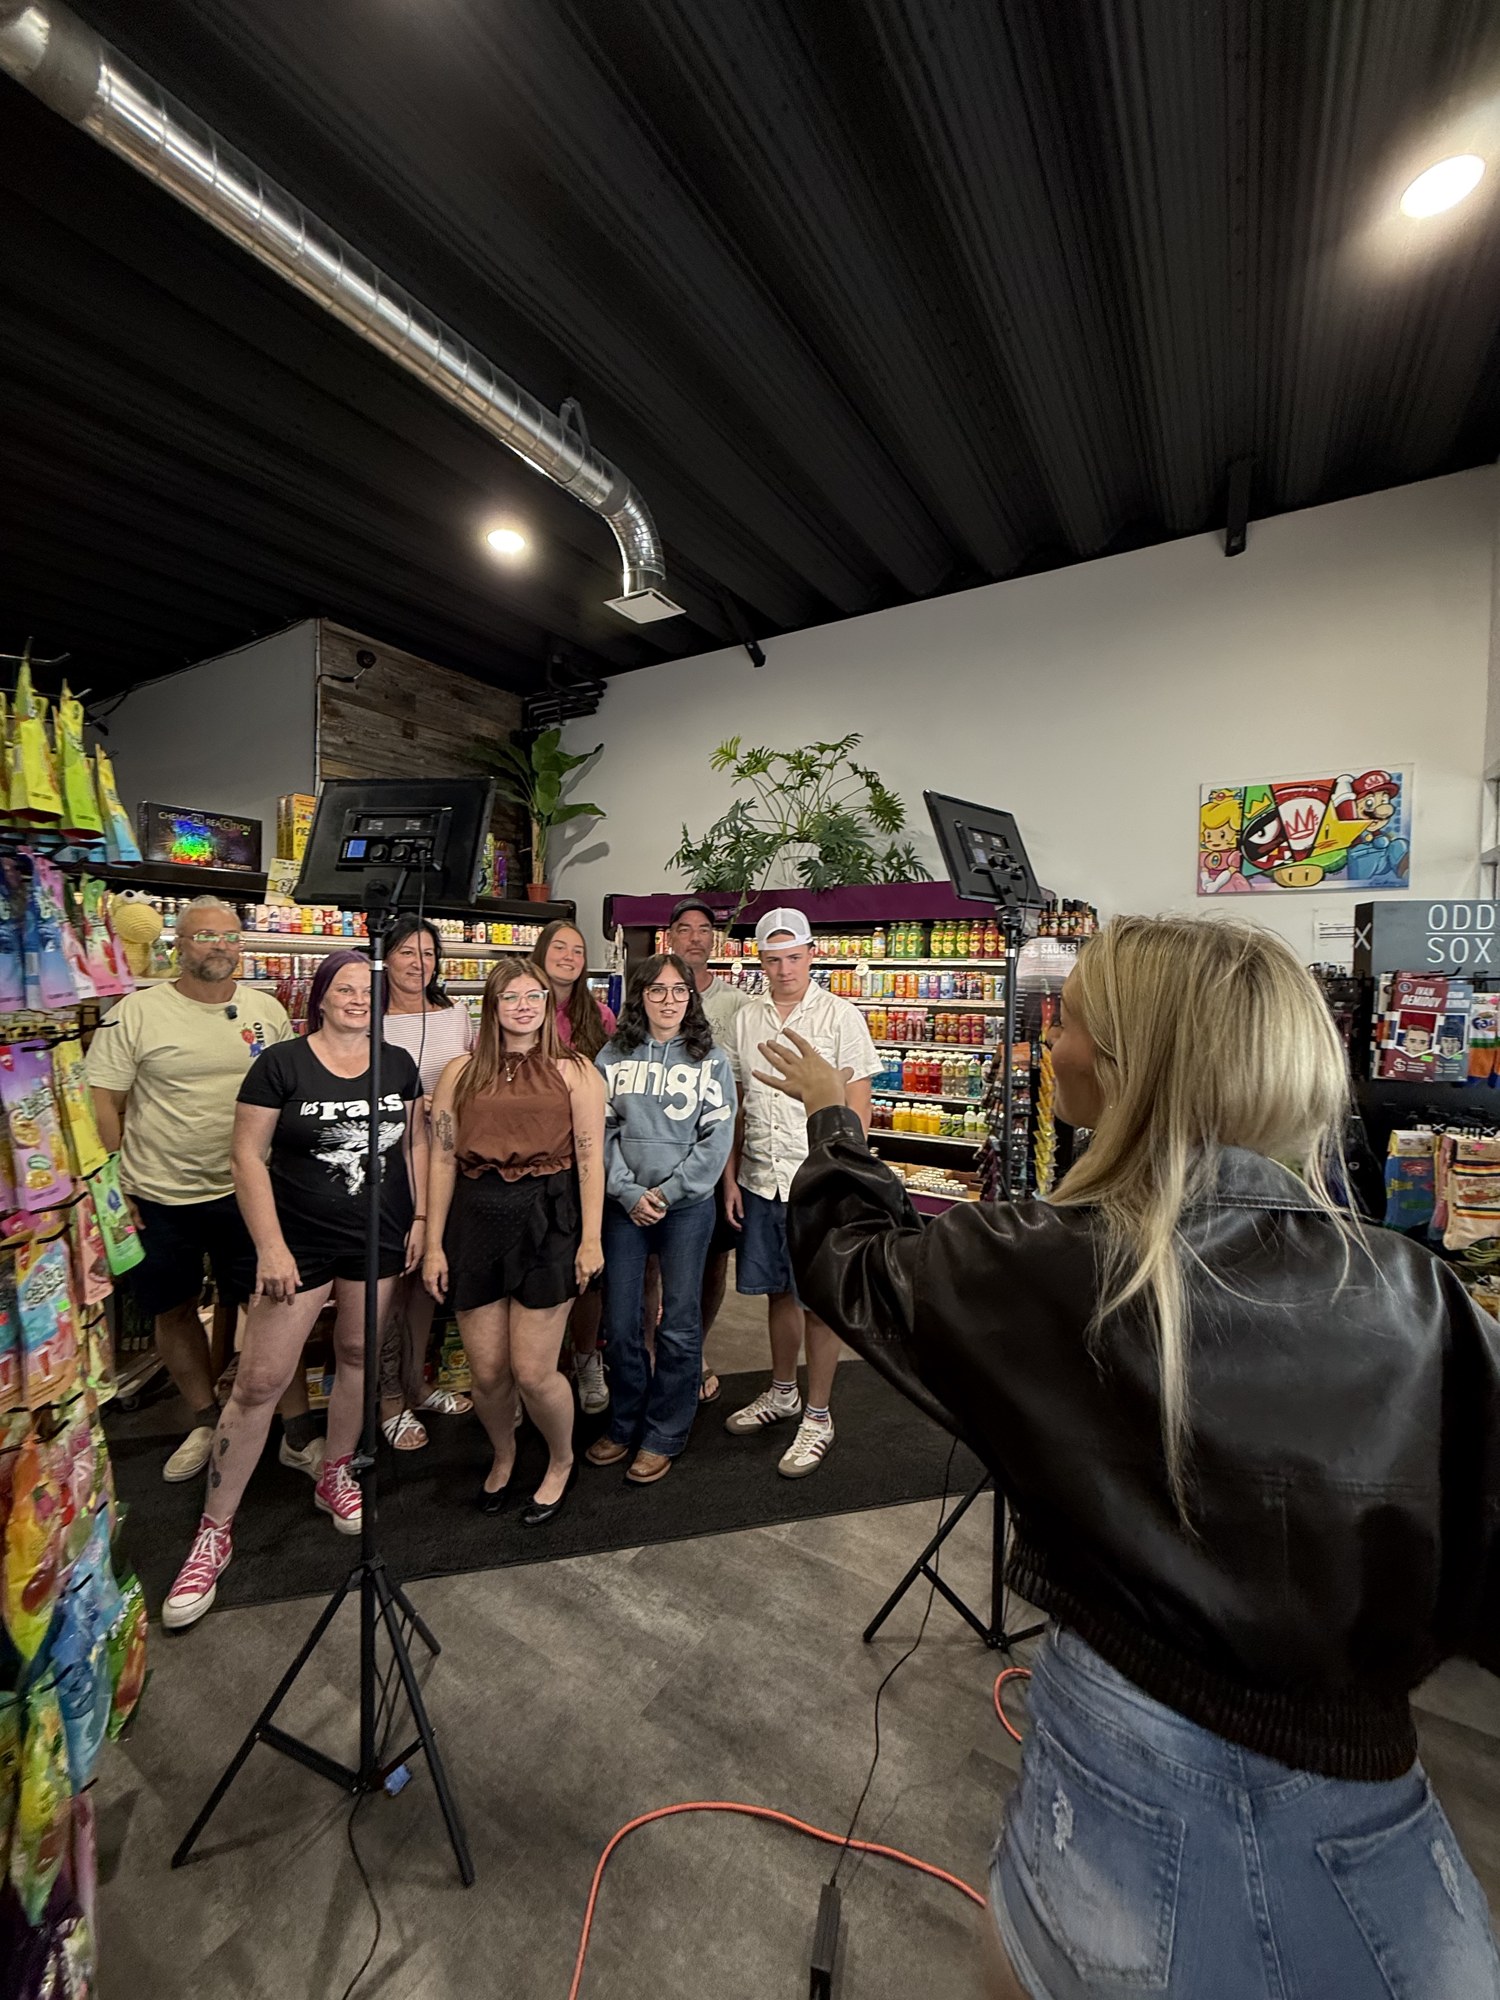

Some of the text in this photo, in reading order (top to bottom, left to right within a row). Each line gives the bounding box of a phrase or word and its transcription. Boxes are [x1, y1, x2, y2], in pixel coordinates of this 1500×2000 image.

[1428, 904, 1495, 931] ODD
[1041, 944, 1077, 954] SAUCES
[1426, 937, 1492, 963] SOX
